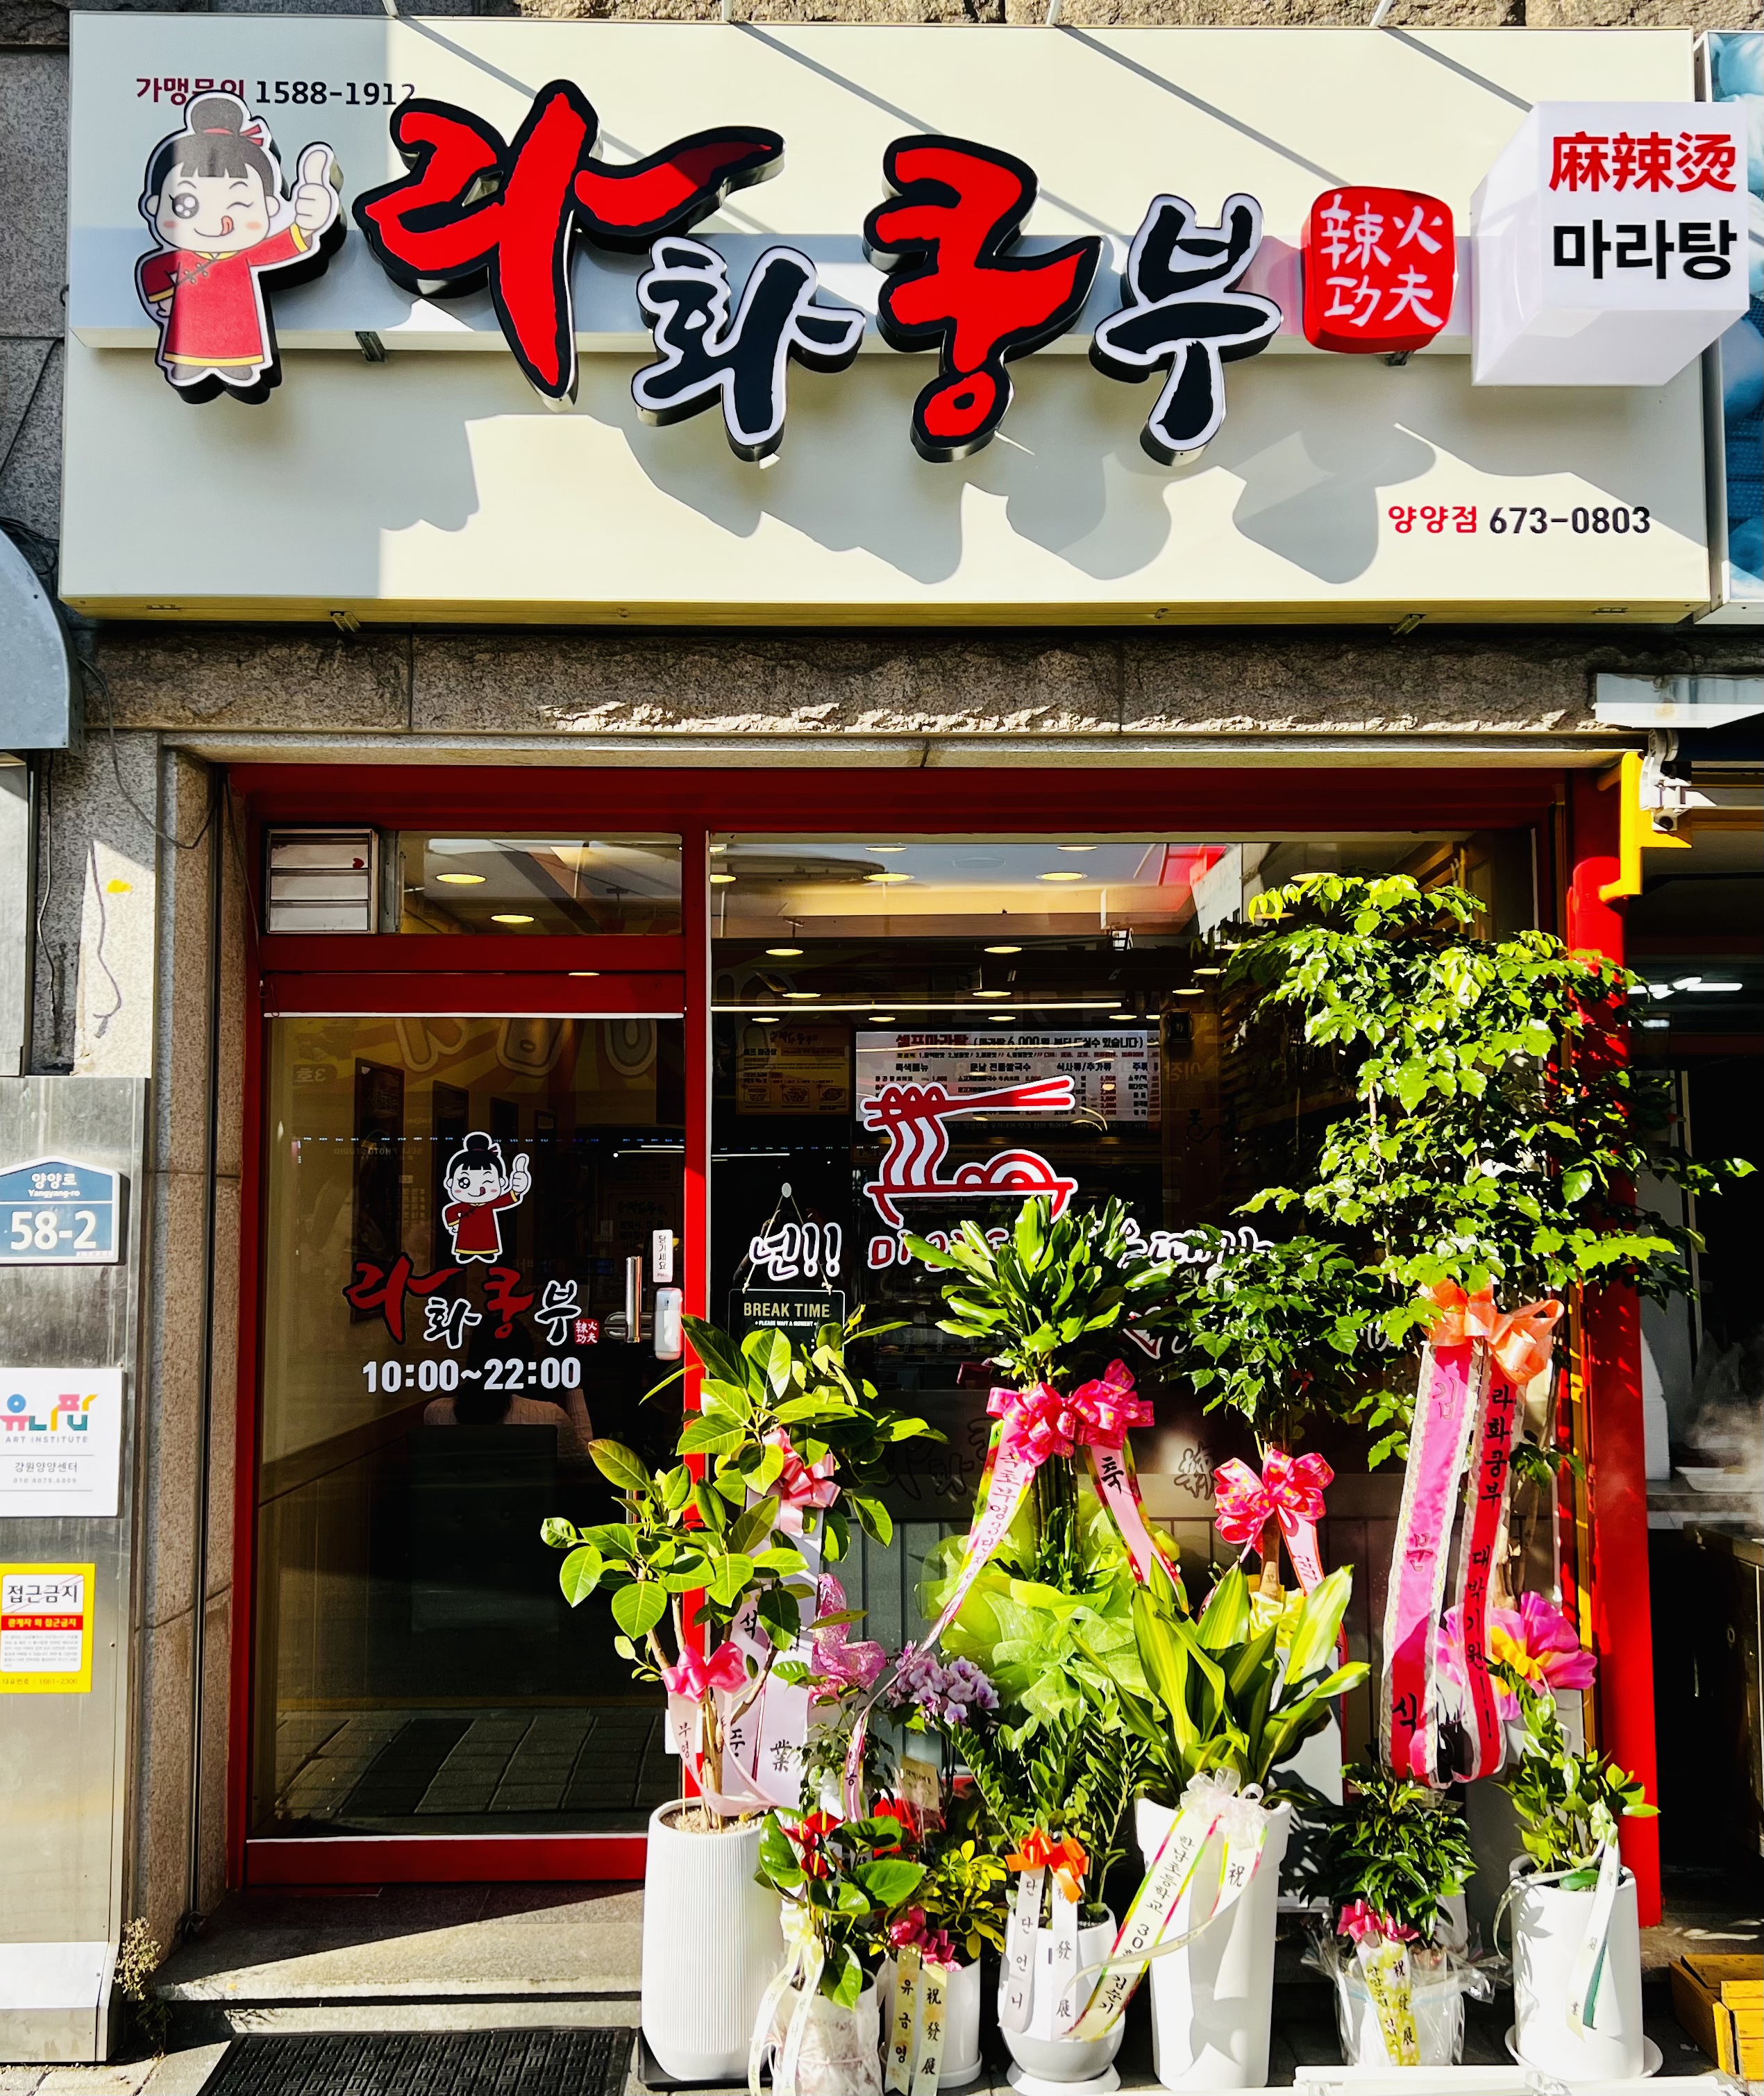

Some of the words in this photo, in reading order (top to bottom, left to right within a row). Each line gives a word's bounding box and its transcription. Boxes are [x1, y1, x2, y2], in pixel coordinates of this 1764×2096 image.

[257, 81, 416, 106] 1588-1912
[1549, 131, 1737, 192] 麻辣烫
[1554, 219, 1738, 280] 마라탕
[1388, 505, 1477, 533] 양양점
[1490, 506, 1651, 534] 673-0803
[1102, 1037, 1143, 1049] 있습니다)
[28, 1189, 81, 1198] Yangyang-ro
[31, 1173, 77, 1189] 양양로
[11, 1210, 96, 1250] 58-2
[658, 1234, 666, 1270] 당기세요
[342, 1252, 582, 1350] 라화쿵부
[744, 1302, 790, 1317] BREAK
[793, 1303, 830, 1318] TIME
[362, 1357, 582, 1393] 10:00~22:00
[1479, 1383, 1514, 1507] 라화쿵부
[15, 1461, 78, 1473] 강원양양센터
[1100, 1456, 1125, 1494] 축
[8, 1584, 78, 1603] 접근금지
[1228, 1862, 1245, 1888] 祝
[921, 1988, 941, 2075] 祝發展
